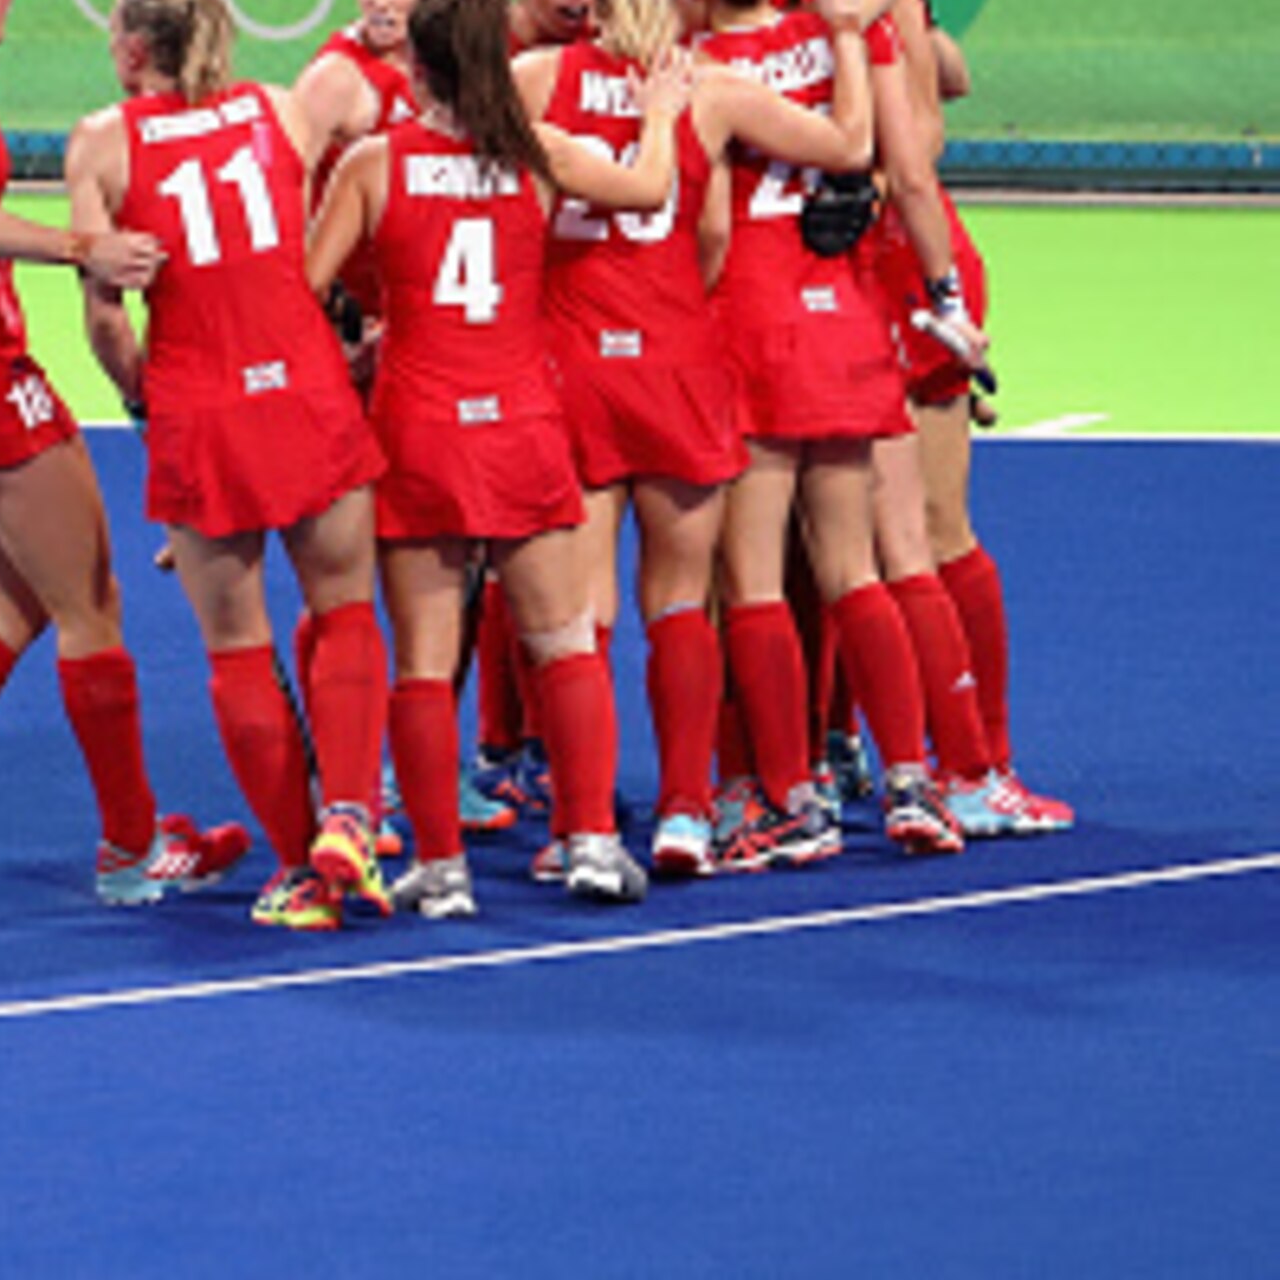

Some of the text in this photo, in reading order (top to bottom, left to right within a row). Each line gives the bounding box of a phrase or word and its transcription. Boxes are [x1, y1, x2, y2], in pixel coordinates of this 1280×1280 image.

[157, 148, 280, 266] 11
[433, 218, 503, 324] 4
[5, 375, 55, 430] 18
